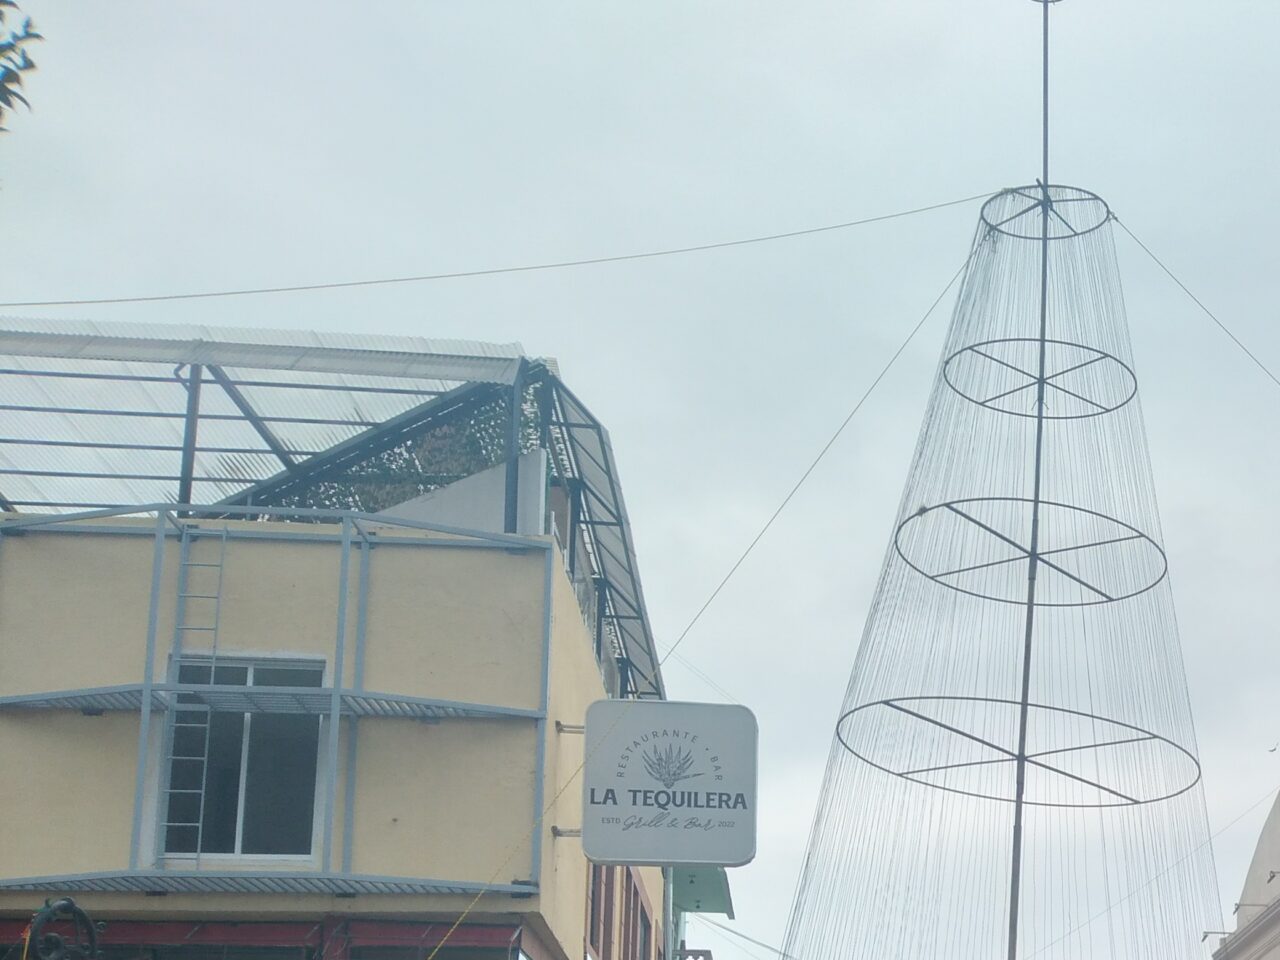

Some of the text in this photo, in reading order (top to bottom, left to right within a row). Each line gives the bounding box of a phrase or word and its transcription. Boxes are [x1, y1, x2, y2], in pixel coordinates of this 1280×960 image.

[616, 729, 723, 782] RESTAURANTE BAR
[590, 788, 748, 811] LA TEQUILERA
